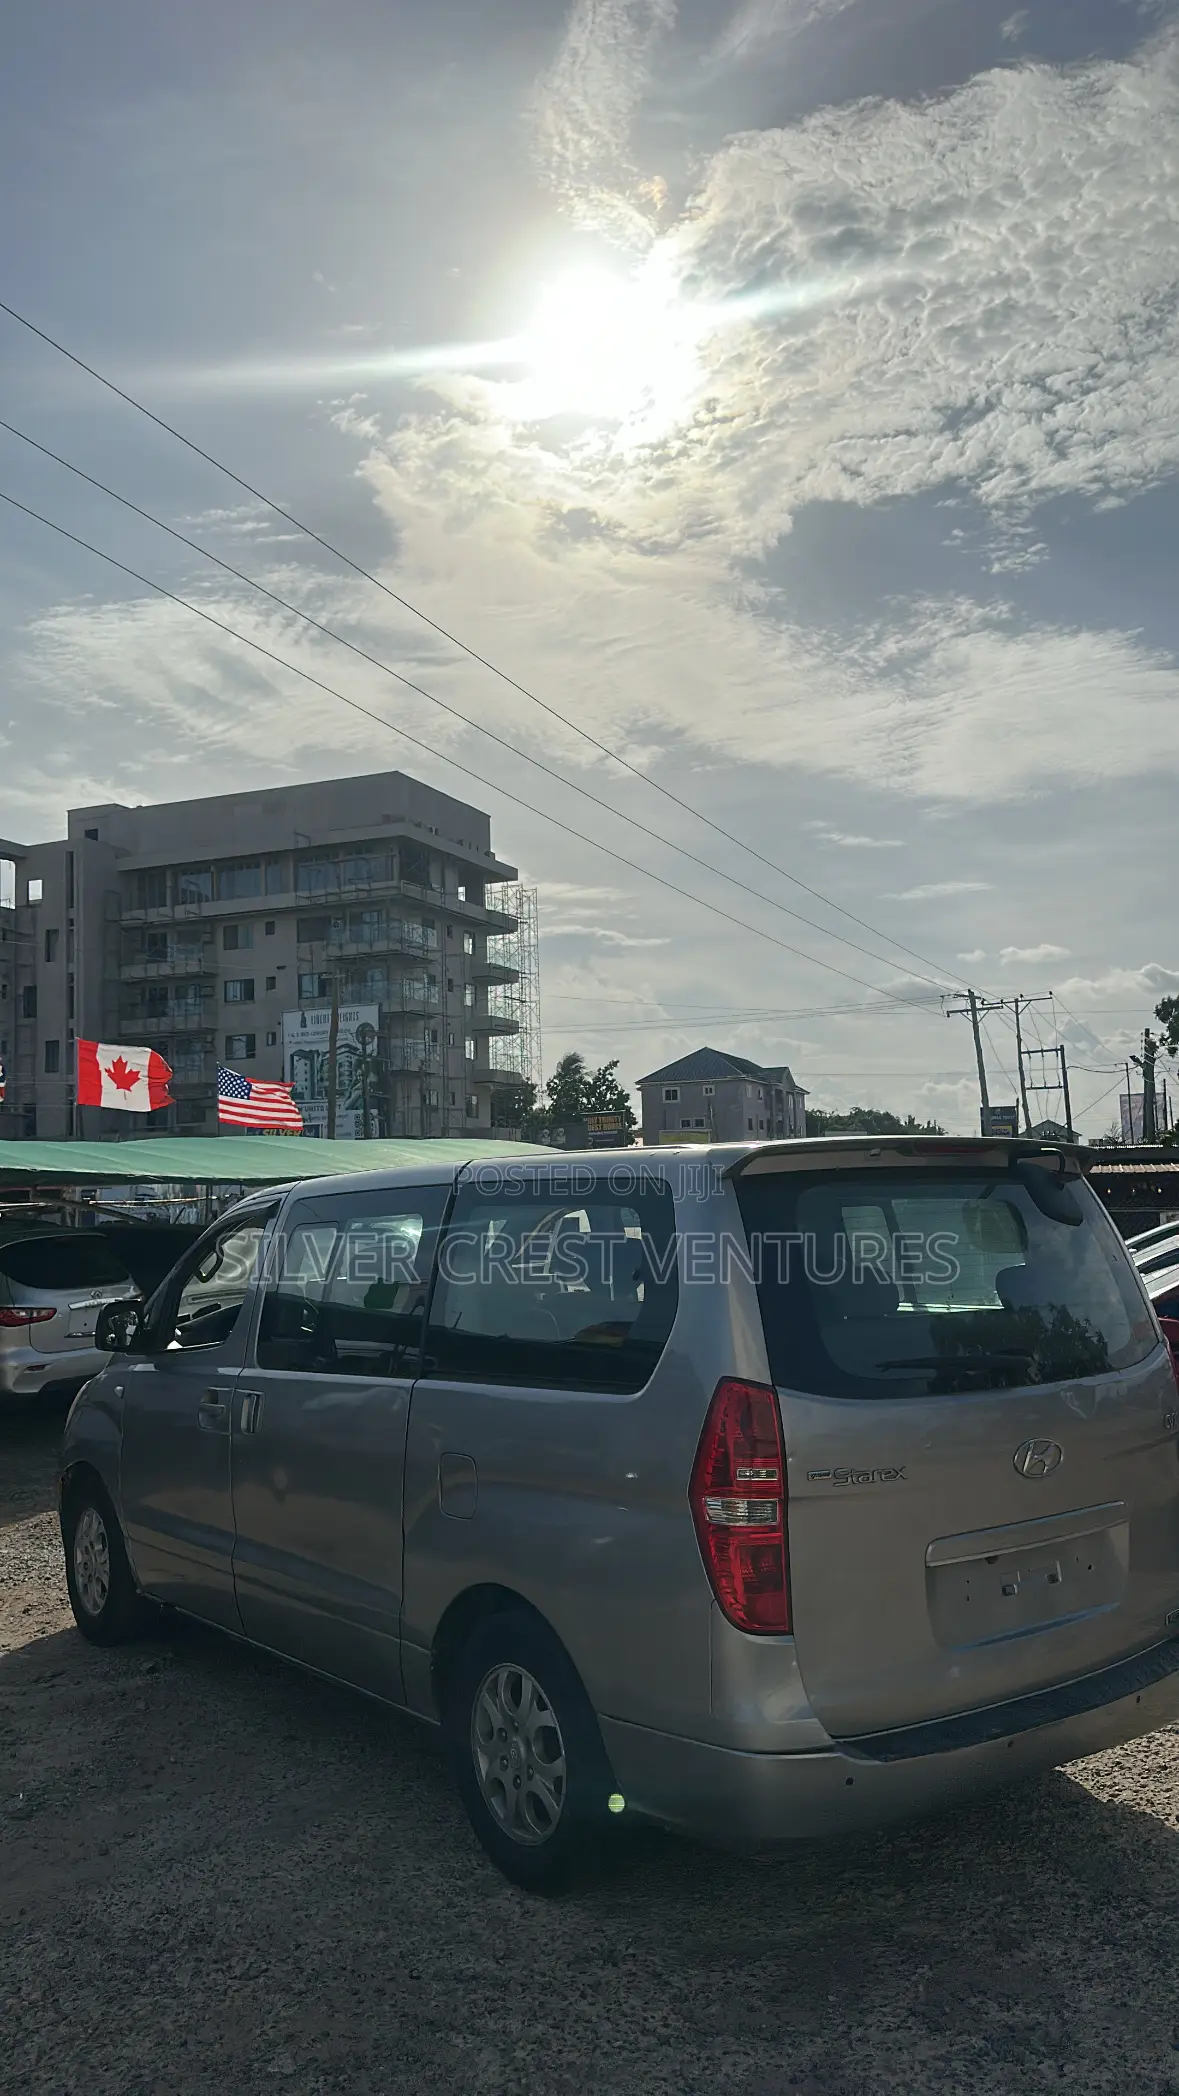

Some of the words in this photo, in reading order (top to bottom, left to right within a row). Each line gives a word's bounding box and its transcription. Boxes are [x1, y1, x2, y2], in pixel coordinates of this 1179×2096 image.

[311, 1013, 332, 1025] LIBERT
[338, 1011, 360, 1023] EIGHTS
[833, 1466, 908, 1487] Starex
